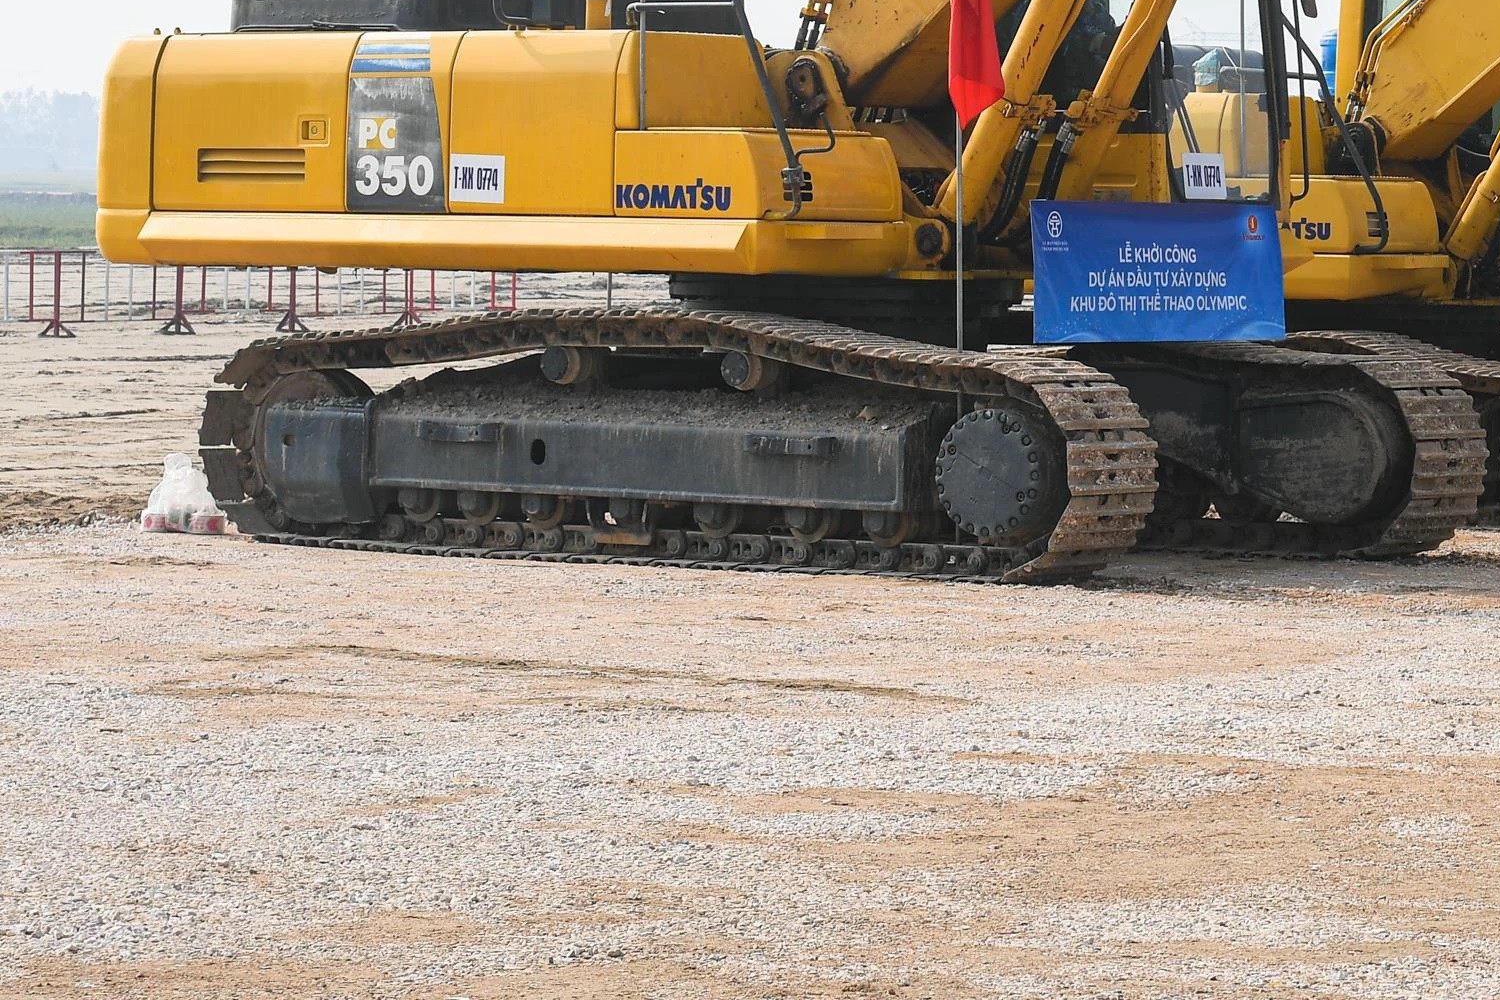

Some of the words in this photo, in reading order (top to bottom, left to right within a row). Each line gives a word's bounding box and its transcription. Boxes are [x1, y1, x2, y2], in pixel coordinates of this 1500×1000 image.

[358, 117, 397, 149] PC
[355, 155, 434, 197] 350
[476, 167, 498, 191] 0774
[1203, 165, 1222, 188] 0774
[615, 178, 731, 211] KOMATSU
[1119, 240, 1133, 263] LỄ
[1134, 242, 1163, 264] KHỞI
[1164, 243, 1197, 264] CÔNG
[1088, 268, 1107, 292] DỰ
[1108, 267, 1125, 287] ÁN
[1126, 265, 1152, 287] ĐẦU
[1153, 269, 1169, 287] TƯ
[1171, 267, 1193, 287] XÂY
[1195, 269, 1227, 291] DỰNG
[1070, 295, 1096, 312] KHU
[1098, 292, 1117, 312] ĐÔ
[1118, 295, 1137, 316] THỊ
[1139, 288, 1161, 312] THỂ
[1163, 295, 1195, 312] THAO
[1196, 295, 1248, 312] OLYMPIC
